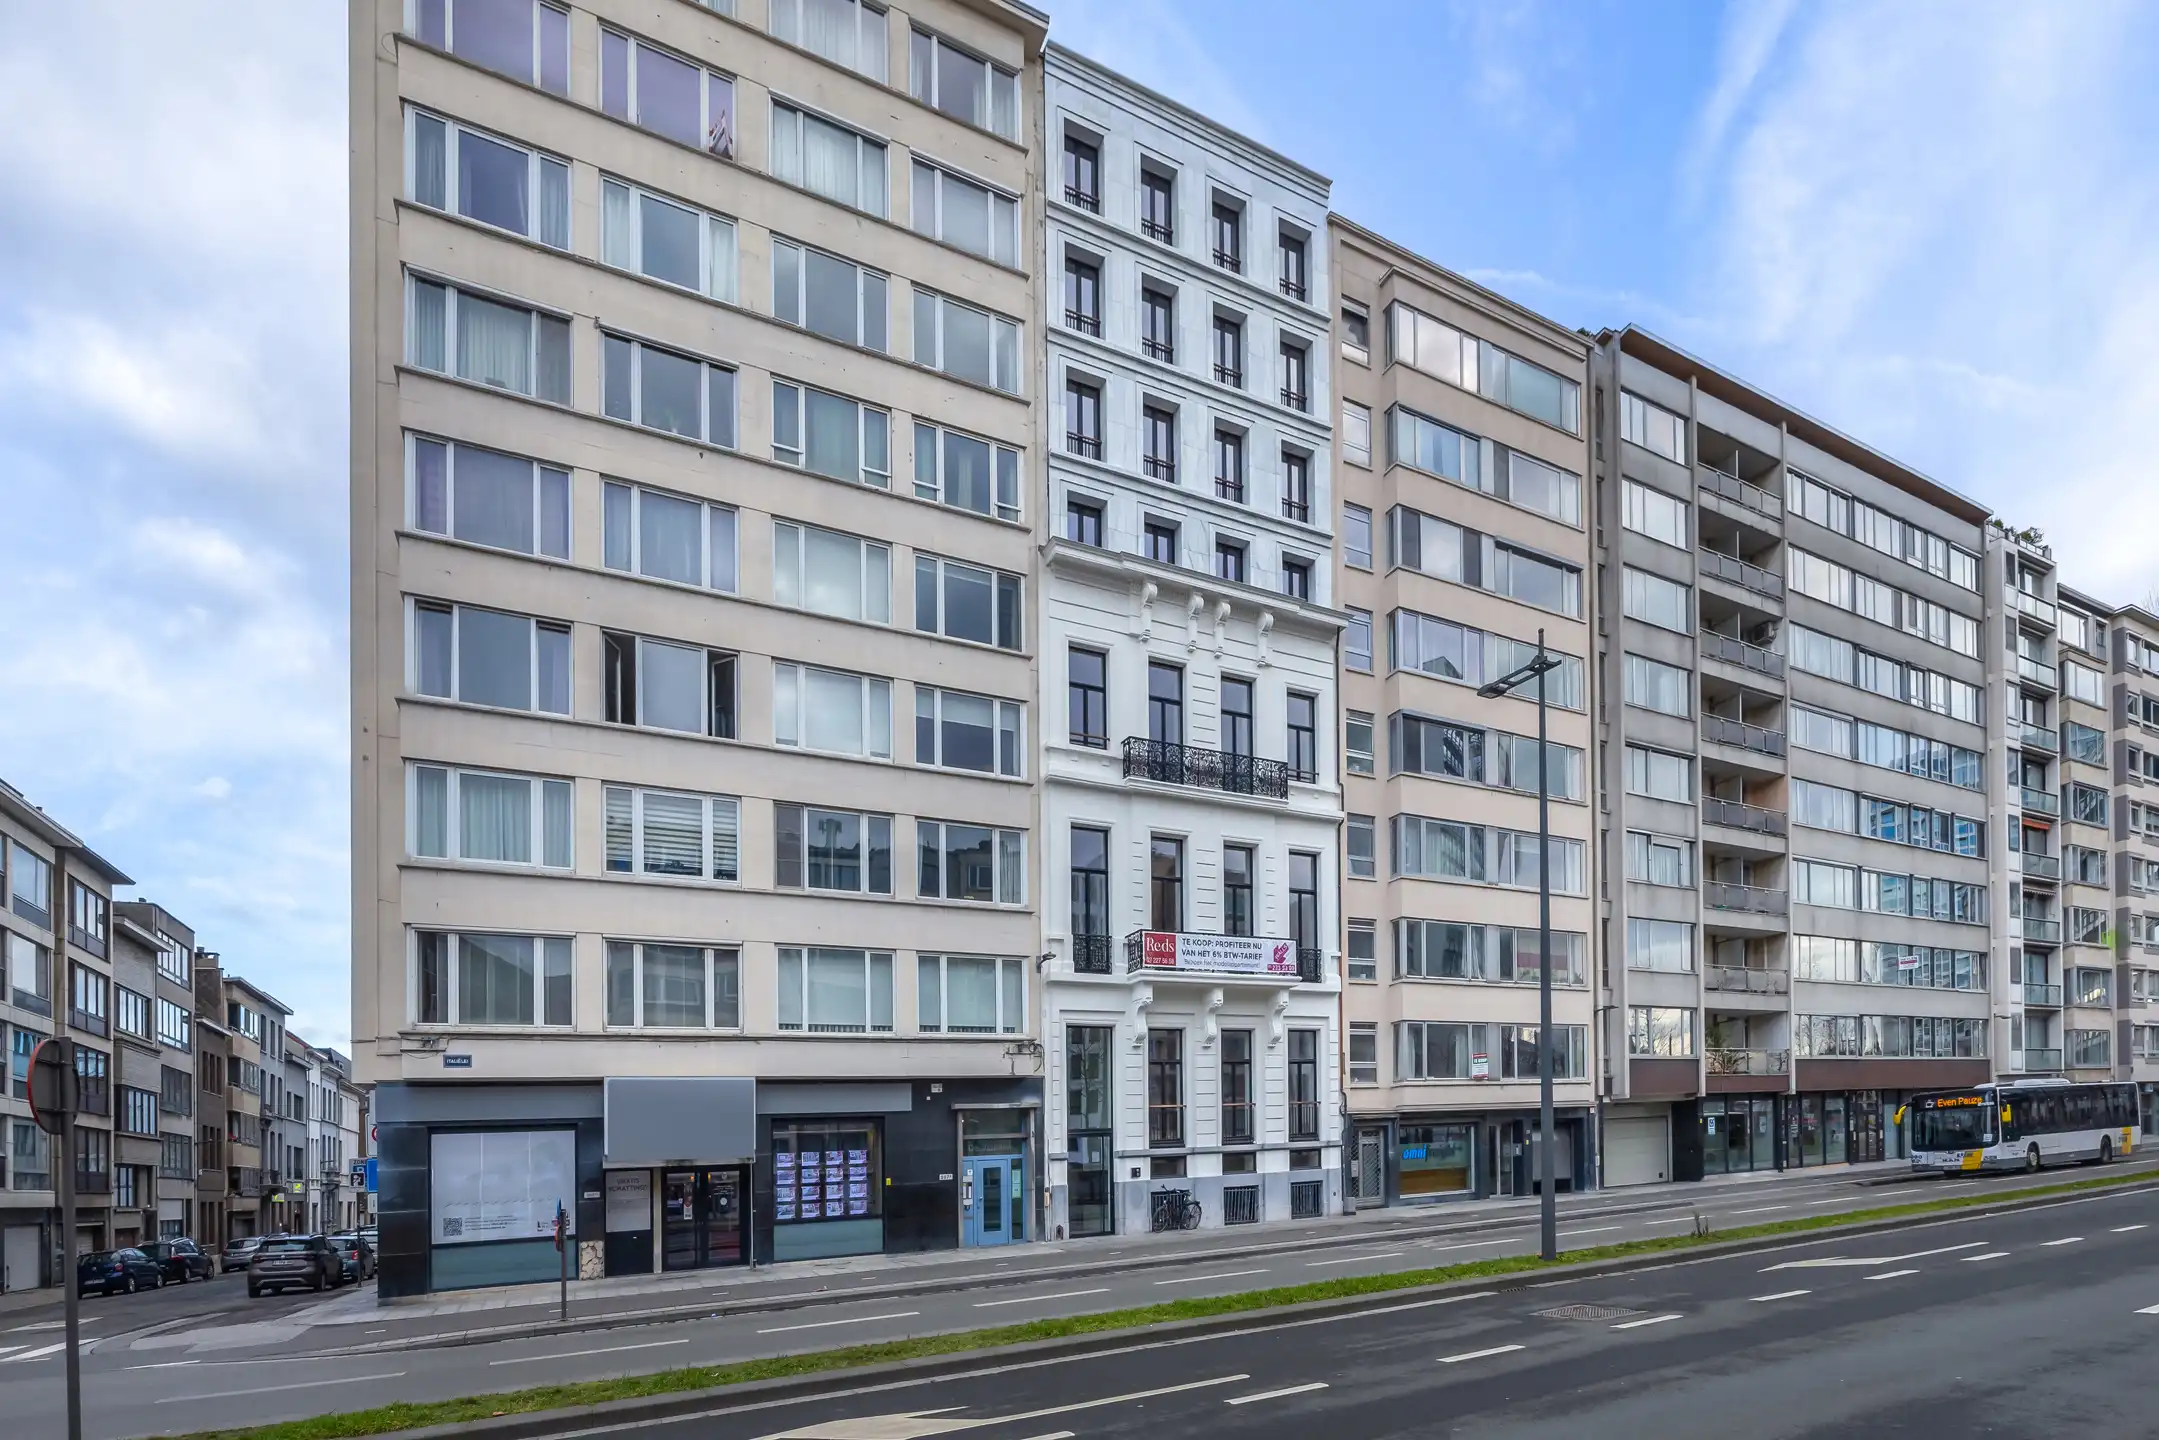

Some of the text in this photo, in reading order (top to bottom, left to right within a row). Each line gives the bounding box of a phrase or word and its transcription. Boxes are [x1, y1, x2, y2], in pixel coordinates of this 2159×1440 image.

[1146, 937, 1175, 953] Reds
[1182, 938, 1262, 950] TE KOOP: PROFITEER NU
[1181, 949, 1196, 957] VAN
[1197, 950, 1211, 958] HET
[1224, 952, 1263, 961] BTW-TARIEF
[1937, 1097, 1983, 1108] Even Pauze
